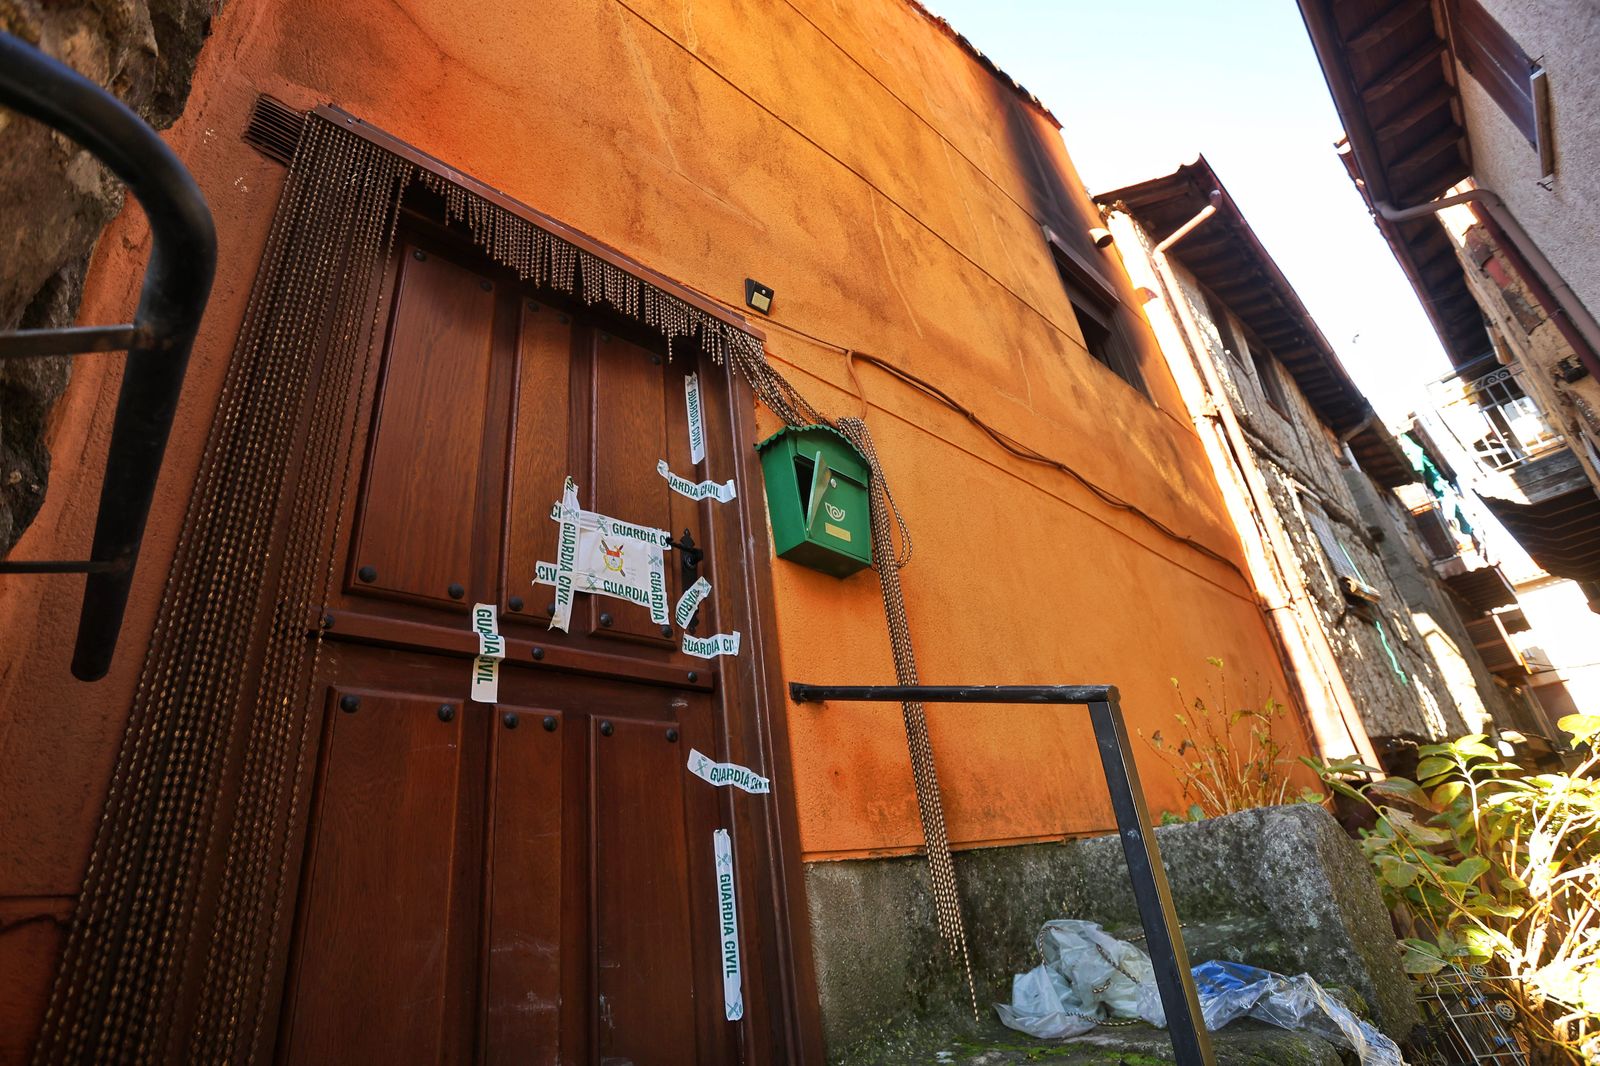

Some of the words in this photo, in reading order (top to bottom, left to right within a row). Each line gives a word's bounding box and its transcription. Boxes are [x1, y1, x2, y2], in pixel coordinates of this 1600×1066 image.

[687, 390, 699, 427] GUARDIA
[691, 427, 701, 450] CIVIL
[559, 522, 576, 573] GUARDIA
[612, 523, 657, 544] GUARDIA
[537, 565, 558, 582] CIV
[557, 576, 572, 606] CIVIL
[603, 580, 650, 604] GUARDIA
[650, 571, 665, 620] GUARDIA
[476, 608, 500, 655] GUADIA
[710, 767, 750, 788] GUARDIA
[719, 873, 735, 936] GUARDIA
[724, 940, 737, 979] CIVIL
